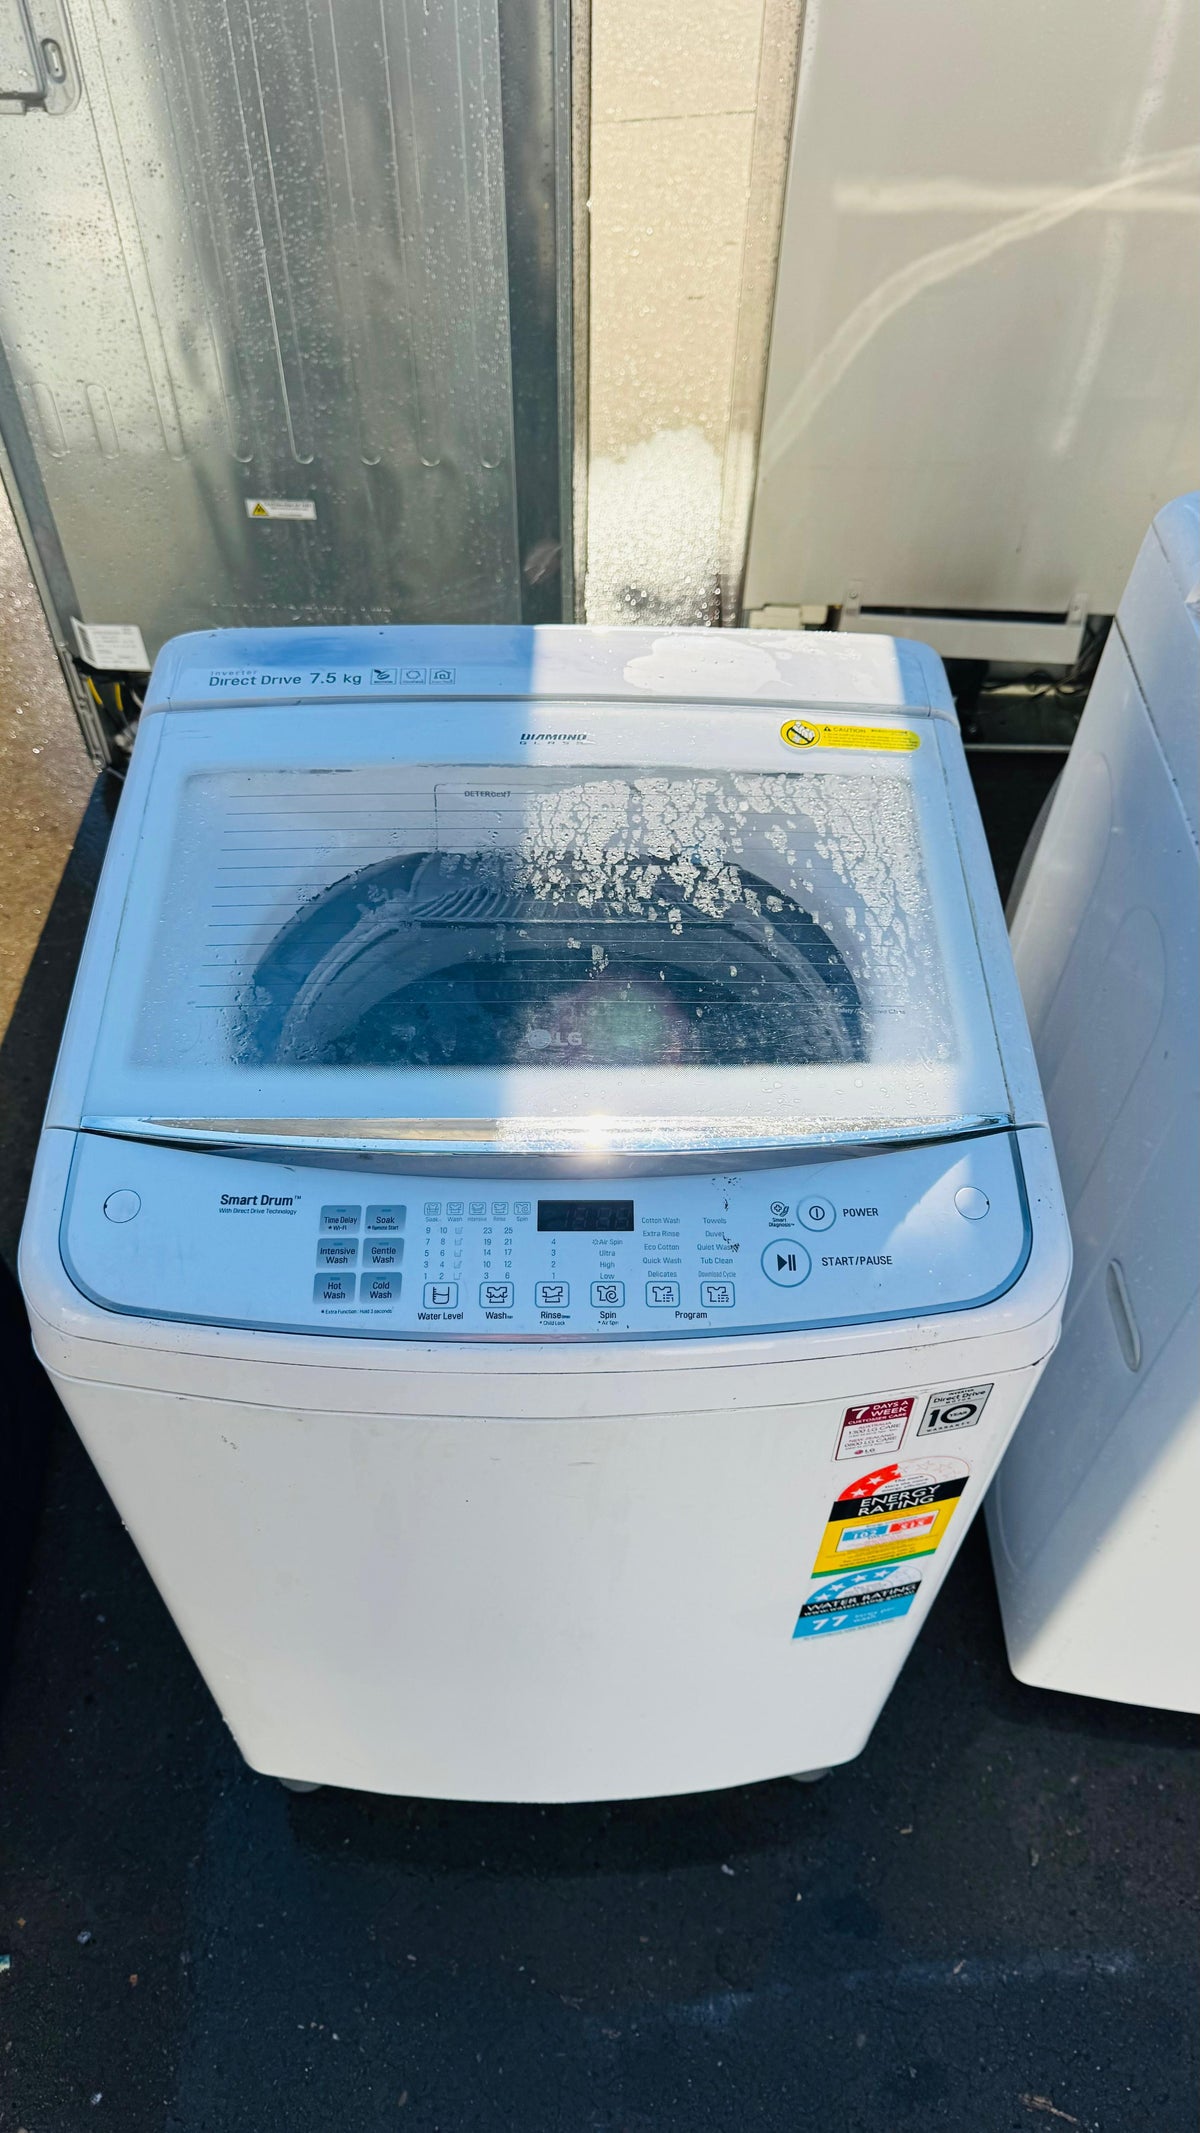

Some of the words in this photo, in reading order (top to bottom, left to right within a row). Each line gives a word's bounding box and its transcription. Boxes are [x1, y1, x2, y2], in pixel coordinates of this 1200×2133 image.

[209, 676, 257, 686] Direct
[261, 675, 302, 685] Drive
[310, 672, 337, 684] 7.5
[343, 673, 362, 686] kg
[550, 1031, 583, 1046] LG
[220, 1194, 258, 1206] Smart
[266, 1208, 298, 1216] Technology
[843, 1208, 879, 1217] POWER
[340, 1216, 358, 1224] Delay
[320, 1247, 356, 1255] Intensive
[371, 1247, 397, 1255] Gentle
[551, 1249, 556, 1257] 3
[326, 1256, 349, 1264] Wash
[372, 1256, 395, 1264] Wash
[821, 1256, 893, 1266] START/PAUSE
[424, 1272, 428, 1280] 1
[439, 1272, 444, 1280] 2
[484, 1272, 489, 1280] 3
[505, 1272, 510, 1280] 6
[327, 1282, 342, 1290] Hot
[372, 1281, 391, 1290] Cold
[323, 1291, 346, 1299] Wash
[369, 1291, 393, 1299] Wash
[418, 1312, 441, 1320] Water
[442, 1312, 464, 1320] Level
[540, 1311, 561, 1319] Rinse
[600, 1311, 617, 1320] Spin
[675, 1311, 708, 1320] Program
[934, 1395, 960, 1403] Direct
[962, 1390, 986, 1398] Drive
[873, 1401, 899, 1410] DAYS
[851, 1406, 871, 1420] 7
[871, 1406, 908, 1417] WEEK
[928, 1404, 977, 1428] 10
[847, 1415, 887, 1425] CUSTOMER
[860, 1484, 941, 1508] ENERGY
[858, 1495, 935, 1517] RATING
[806, 1597, 858, 1613] WATER
[861, 1584, 917, 1602] RATING
[812, 1614, 849, 1630] 77
